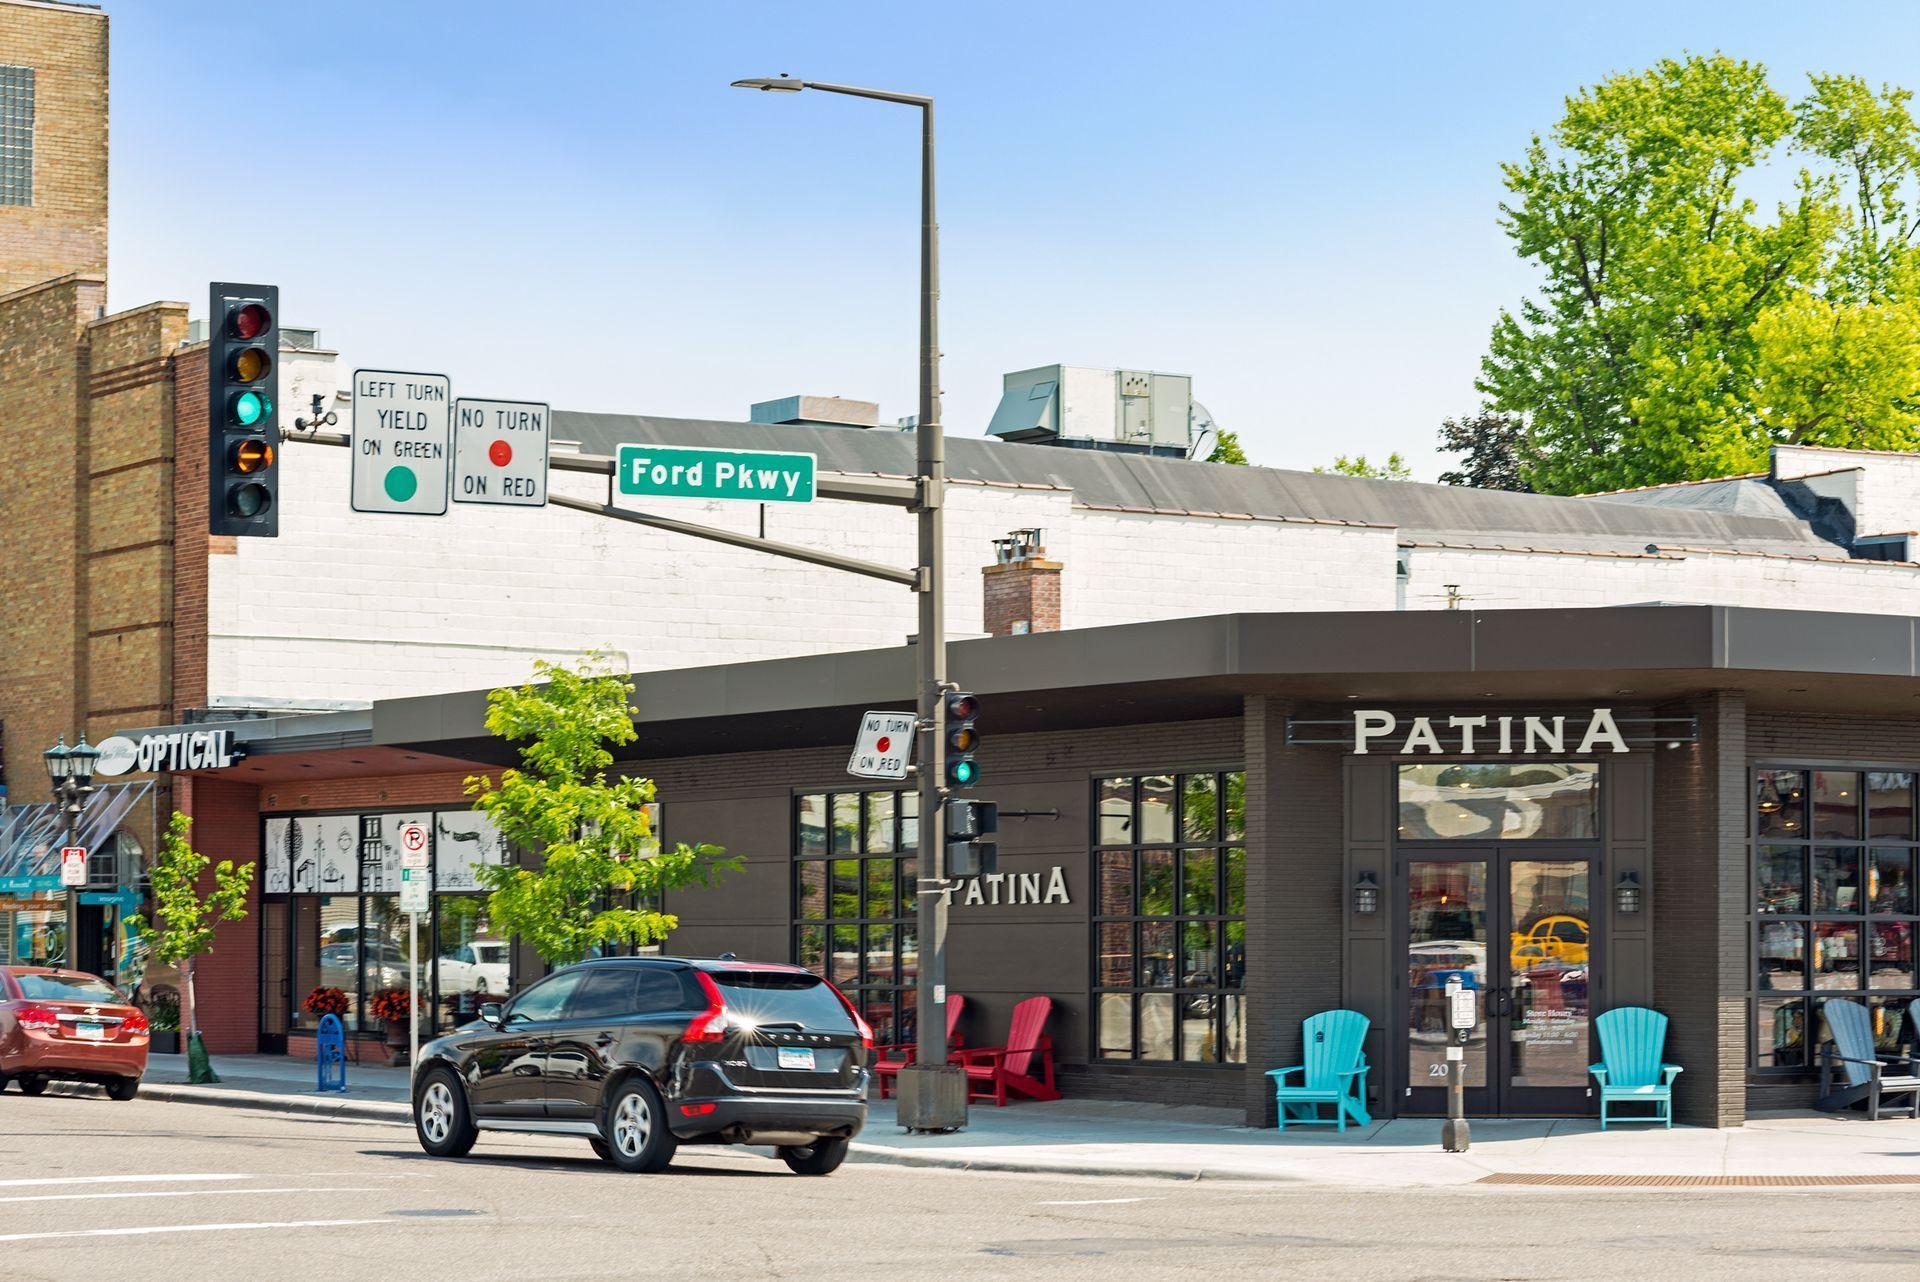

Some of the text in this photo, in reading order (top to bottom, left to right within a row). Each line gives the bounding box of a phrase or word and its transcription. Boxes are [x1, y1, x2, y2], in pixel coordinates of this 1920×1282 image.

[360, 380, 444, 403] LEFT TURN
[377, 408, 427, 431] YIELD
[461, 407, 542, 432] NO TURN
[362, 439, 442, 460] ON GREEN
[464, 475, 536, 498] ON RED
[632, 457, 801, 497] Ford Pkwy
[866, 719, 911, 733] NO TURN
[1353, 708, 1630, 755] PATINA
[138, 730, 231, 772] OPTICAL
[860, 756, 901, 771] ON RED
[1429, 1063, 1467, 1077] 207
